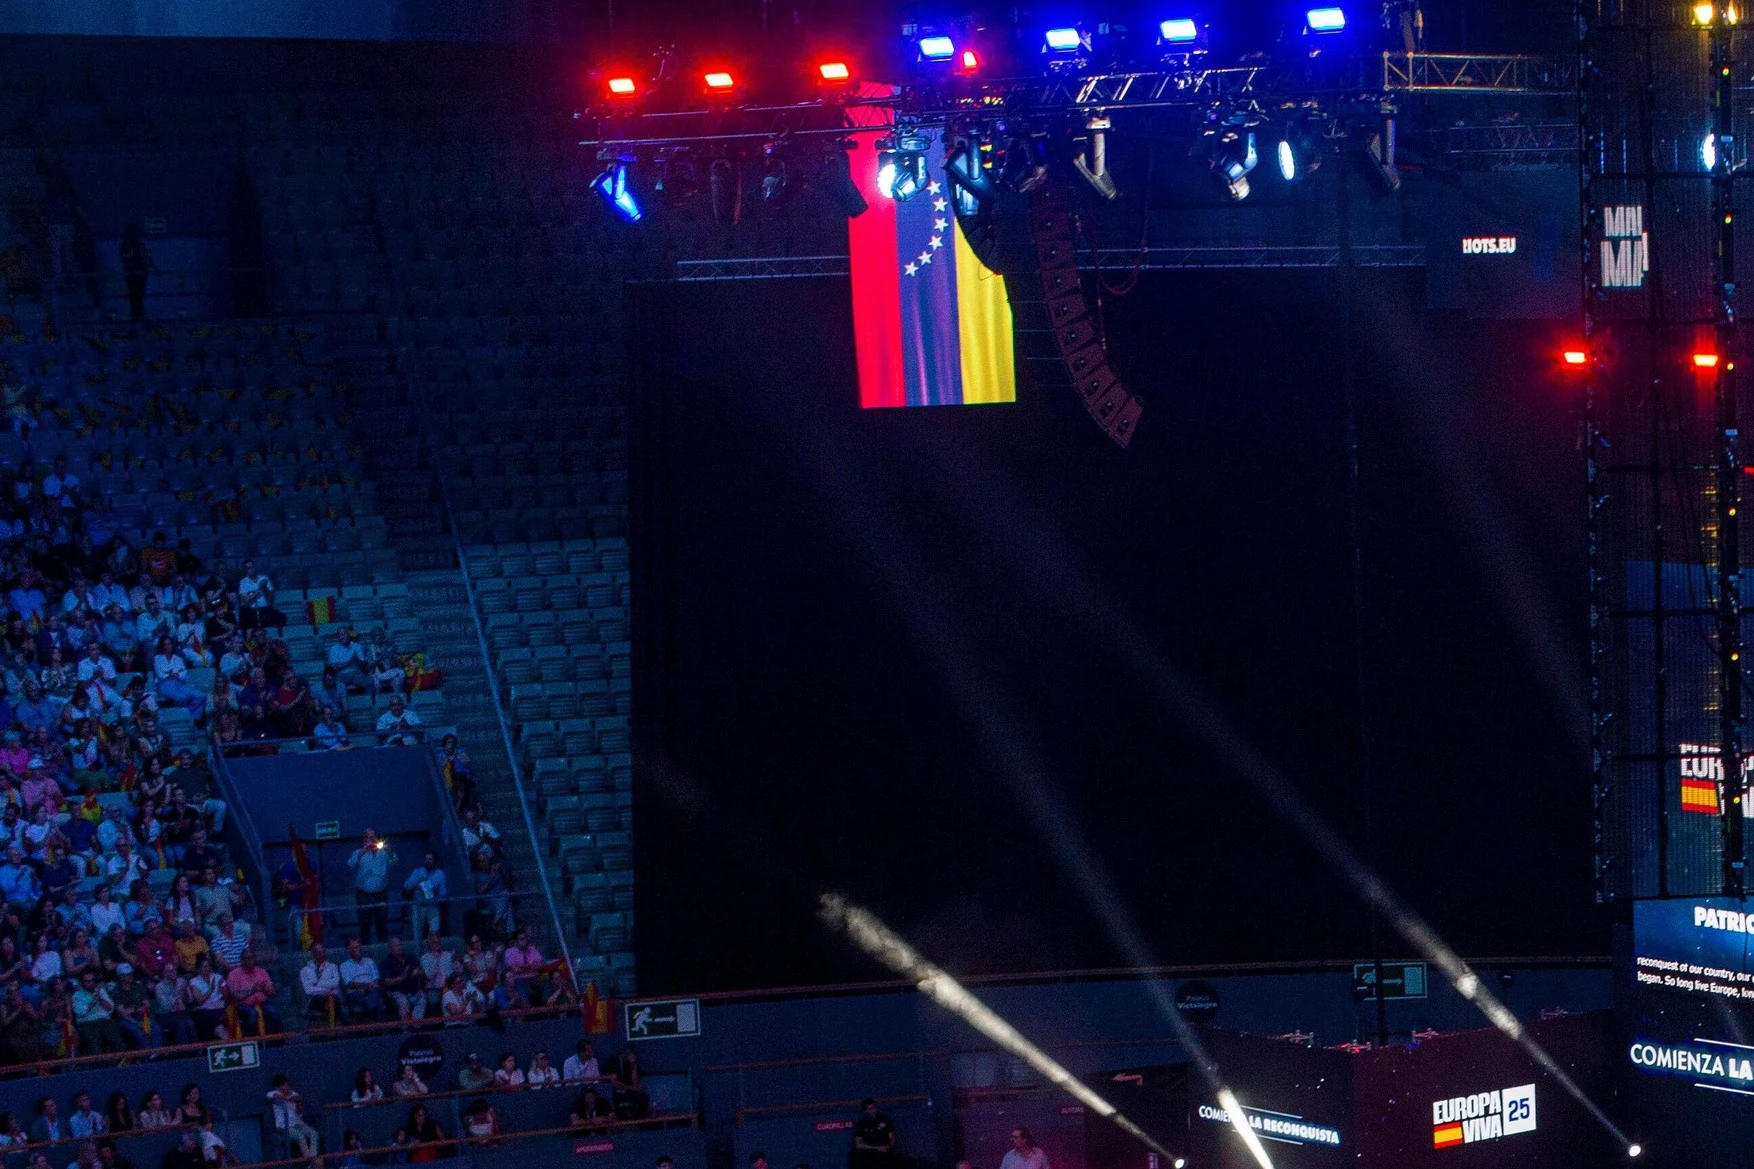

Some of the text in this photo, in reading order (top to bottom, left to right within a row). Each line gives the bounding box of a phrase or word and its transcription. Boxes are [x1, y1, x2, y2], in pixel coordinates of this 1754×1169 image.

[1665, 975, 1675, 986] So
[1677, 976, 1693, 992] long
[1710, 983, 1740, 998] Europe,
[1689, 964, 1703, 975] our
[1737, 971, 1751, 982] our
[1630, 1044, 1725, 1076] COMIENZA
[1728, 1058, 1753, 1080] LA
[1433, 1090, 1530, 1125] EUROPA 25
[1249, 1115, 1262, 1129] LA
[1263, 1118, 1340, 1144] RECONQUISTA
[1462, 1114, 1502, 1144] VIVA
